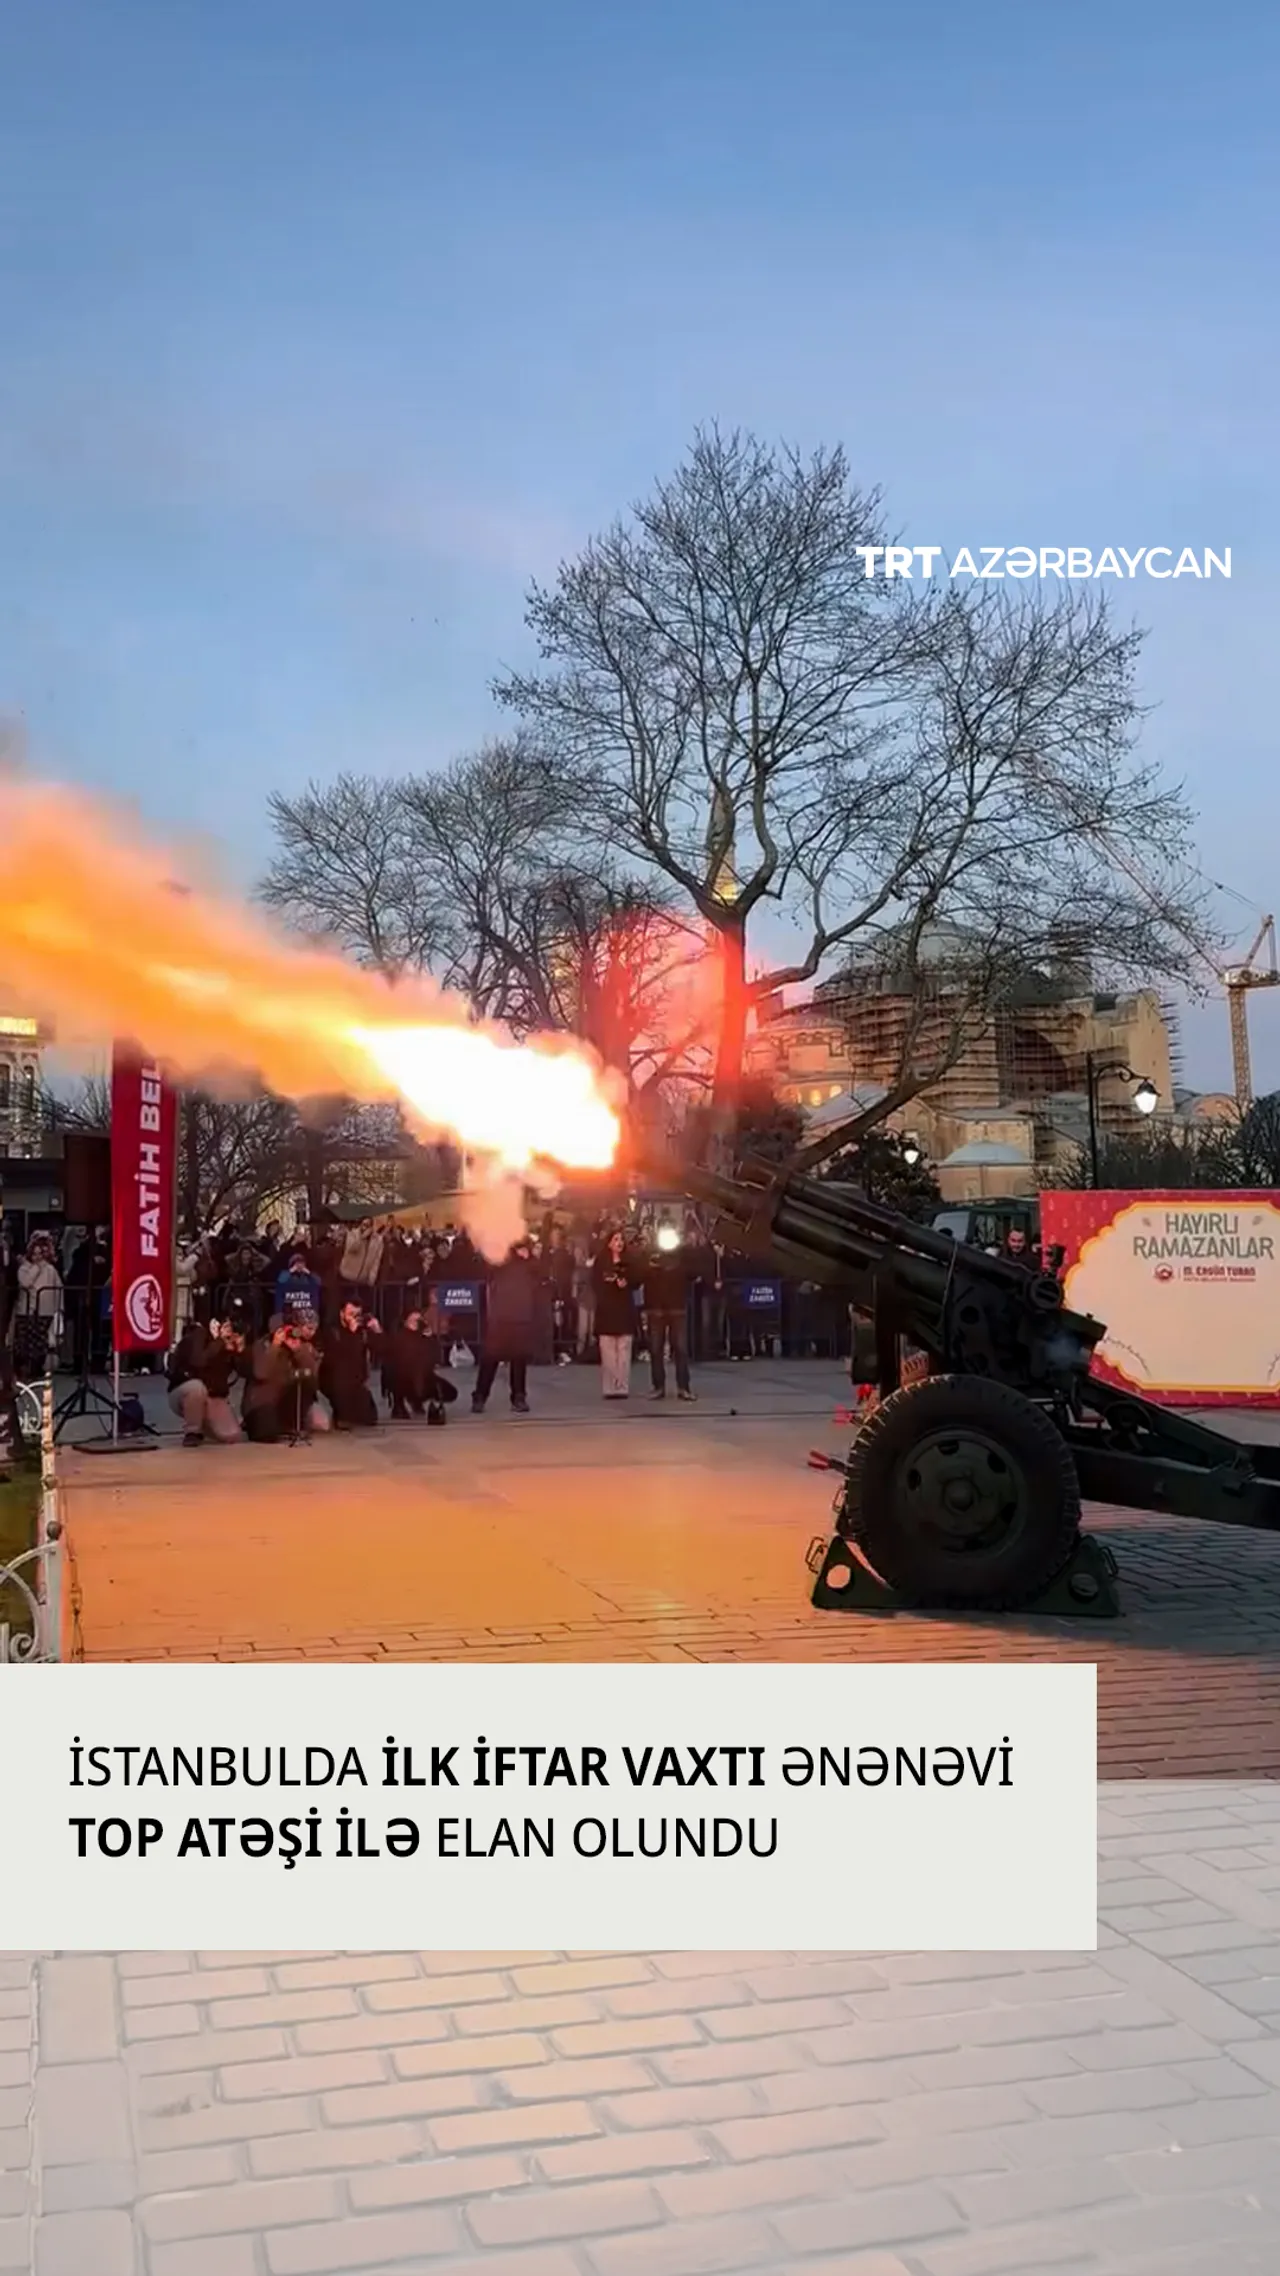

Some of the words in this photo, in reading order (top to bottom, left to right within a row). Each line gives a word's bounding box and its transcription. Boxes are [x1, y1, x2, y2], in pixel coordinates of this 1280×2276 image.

[134, 1142, 161, 1258] FATİH
[1165, 1212, 1239, 1236] HAYIRLI
[1133, 1235, 1274, 1260] RAMAZANLAR
